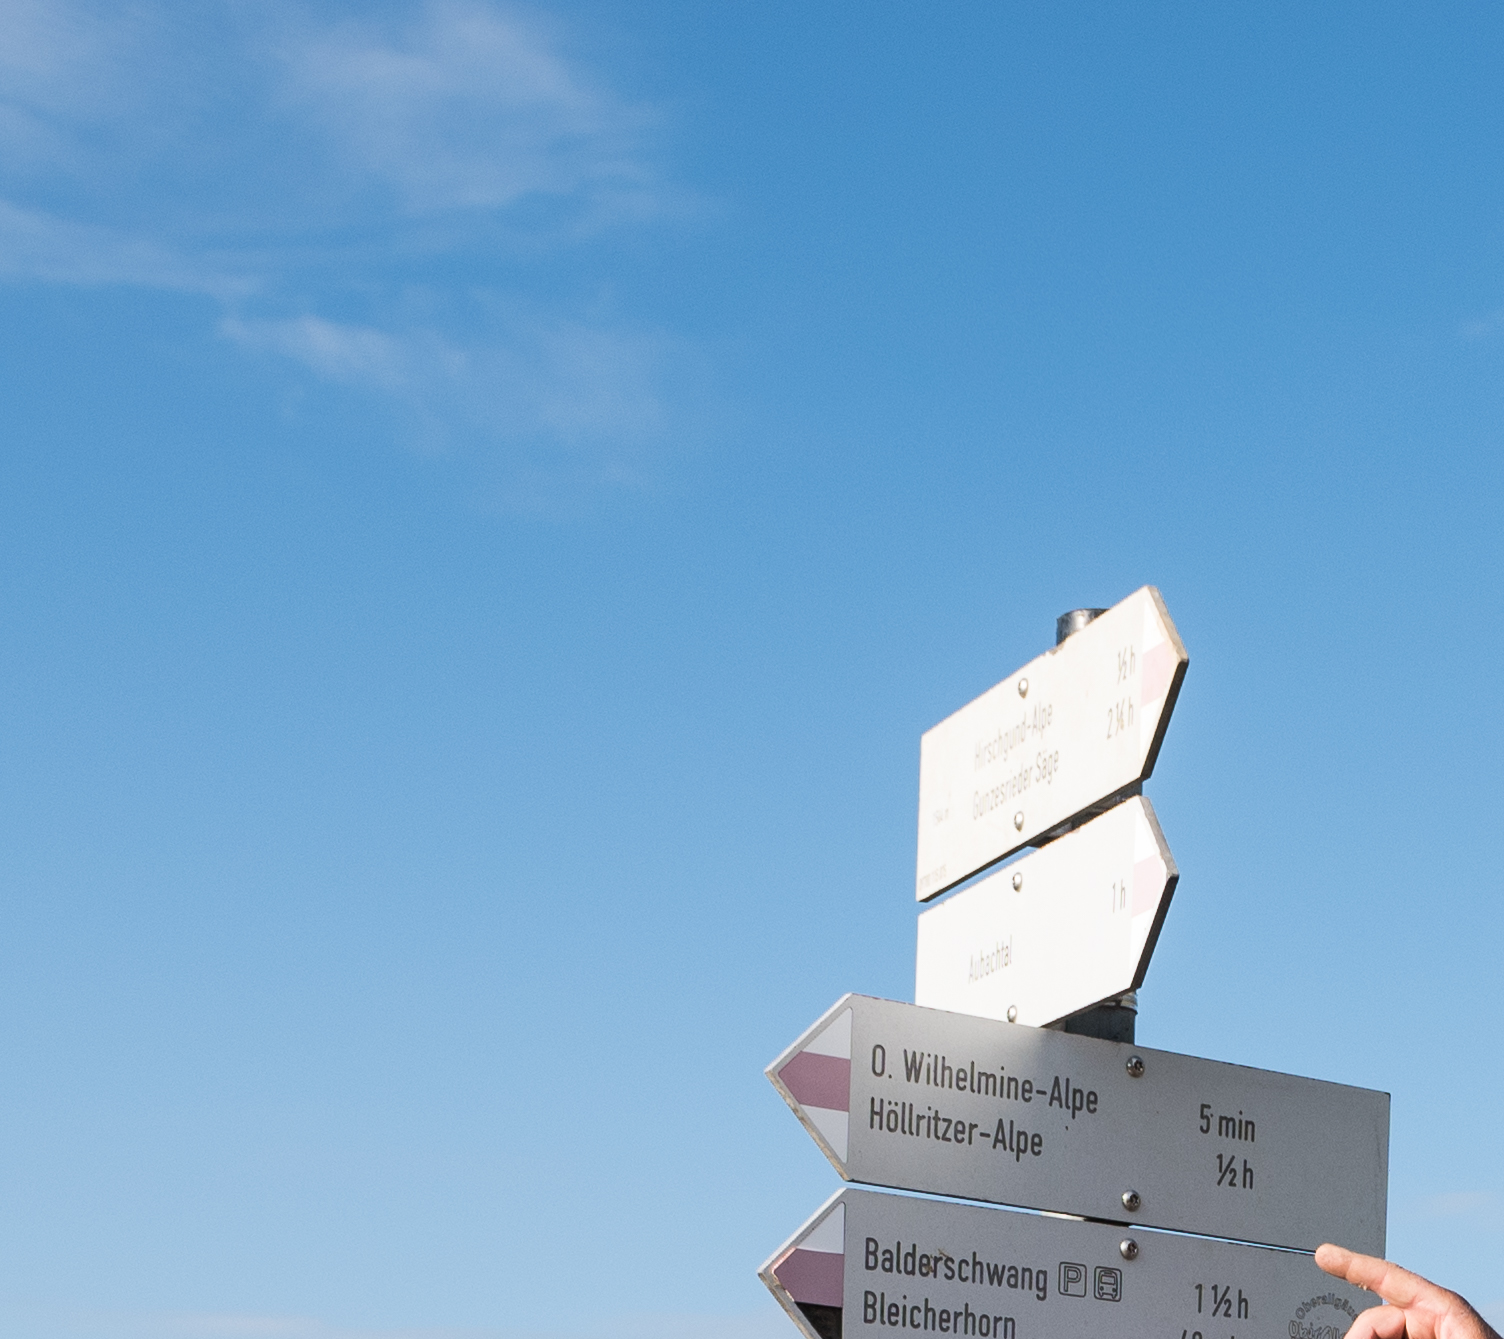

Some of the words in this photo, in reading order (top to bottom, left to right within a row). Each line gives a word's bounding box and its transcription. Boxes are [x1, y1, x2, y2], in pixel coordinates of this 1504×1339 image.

[1129, 644, 1136, 674] h
[1106, 707, 1114, 740] 2
[1127, 695, 1135, 728] h
[972, 762, 1033, 820] Gunzesrieder
[1035, 749, 1059, 786] Säge
[1119, 878, 1127, 909] h
[968, 934, 1013, 984] Aubachtal
[871, 1044, 893, 1080] O.
[903, 1048, 1099, 1115] Wilhelmine-Alpe
[869, 1096, 1044, 1163] Höllritzer-Alpe
[1199, 1103, 1211, 1135] 5
[1217, 1109, 1256, 1143] min
[1242, 1158, 1254, 1190] h
[864, 1237, 1048, 1302] Balderschwang
[1194, 1283, 1203, 1314] 1
[1236, 1289, 1249, 1321] h
